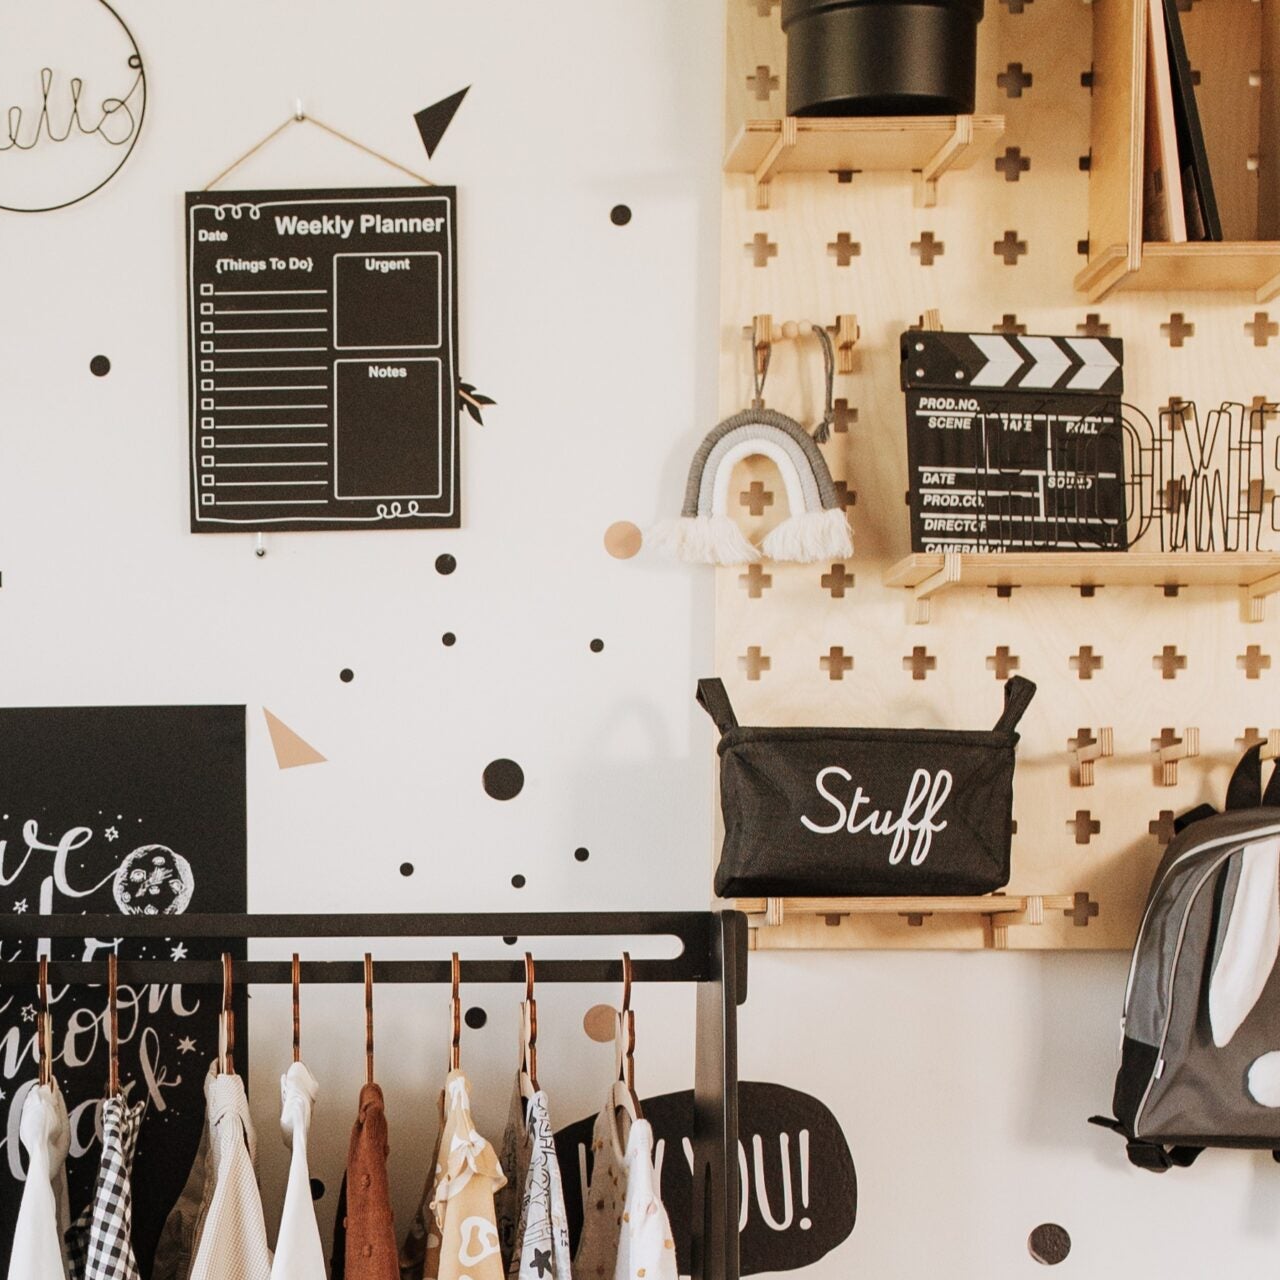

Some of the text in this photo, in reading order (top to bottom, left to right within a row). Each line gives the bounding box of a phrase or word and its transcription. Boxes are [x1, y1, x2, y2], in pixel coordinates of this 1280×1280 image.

[274, 214, 445, 239] Weekly Planner
[197, 229, 229, 243] Date
[269, 258, 287, 271] To
[364, 258, 411, 273] Urgent
[367, 365, 408, 379] Notes
[919, 397, 981, 412] PROD.NO.
[927, 416, 973, 431] SCENE
[922, 473, 956, 485] DATE
[800, 766, 953, 866] Stuff
